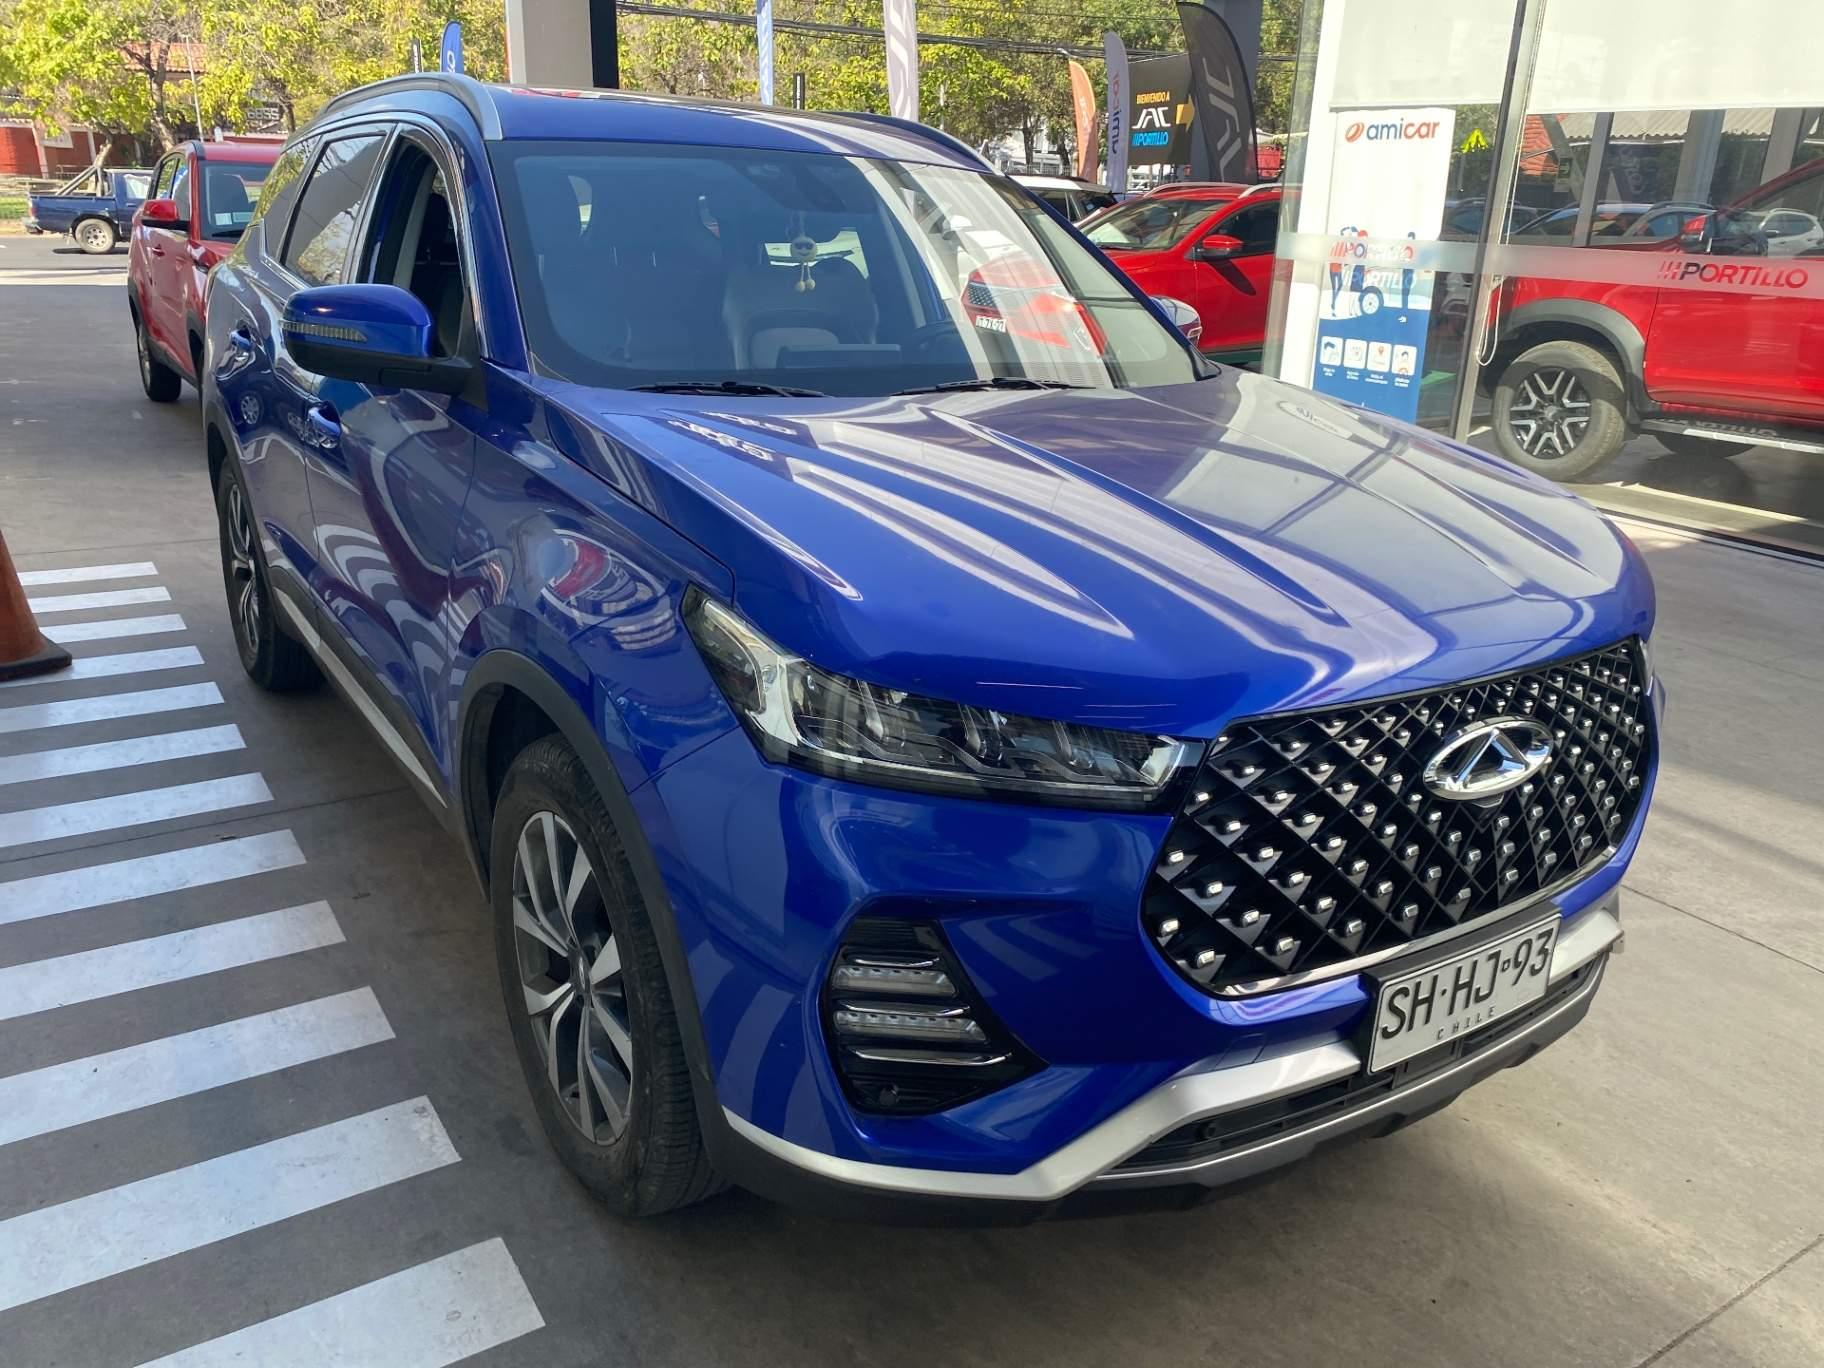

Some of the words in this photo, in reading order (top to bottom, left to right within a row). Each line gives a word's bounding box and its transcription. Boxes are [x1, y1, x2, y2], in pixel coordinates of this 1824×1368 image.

[1136, 92, 1166, 104] BIENVENIDO
[1131, 106, 1172, 129] JAC
[1366, 118, 1441, 141] amicar
[1679, 261, 1809, 289] PORTILLO
[1436, 1006, 1496, 1041] CHILE
